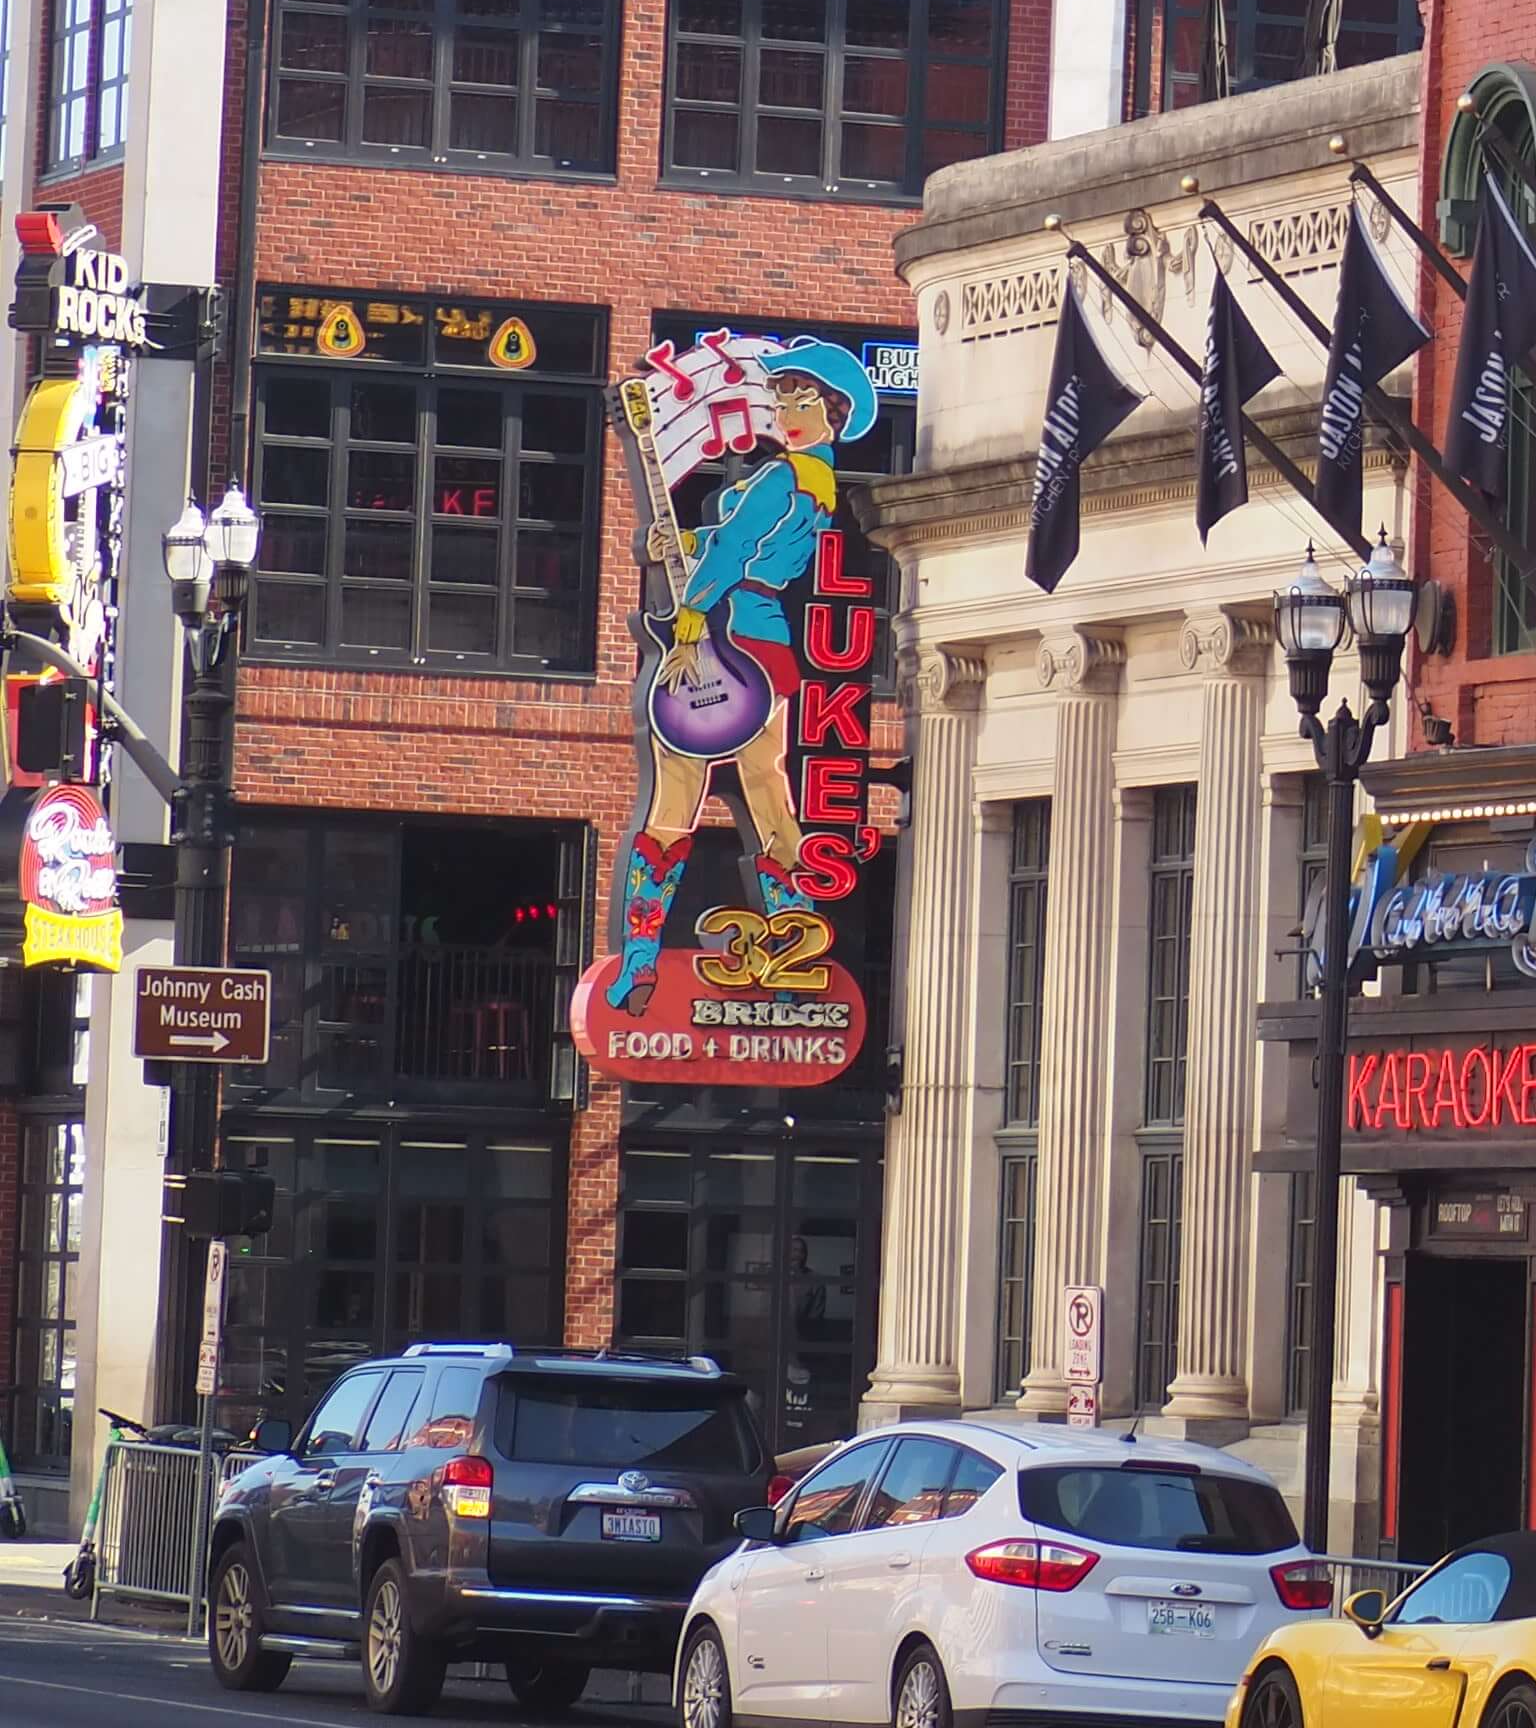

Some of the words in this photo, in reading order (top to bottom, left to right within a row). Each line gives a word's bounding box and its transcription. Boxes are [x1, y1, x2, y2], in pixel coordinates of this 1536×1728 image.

[75, 246, 129, 294] KID
[866, 366, 919, 389] LIGH
[692, 904, 837, 994] 32
[140, 975, 211, 1004] Johnny
[221, 978, 265, 1001] Cash
[160, 1005, 242, 1030] Museum
[691, 998, 851, 1030] BRIDGE
[607, 1030, 694, 1060] FOOD
[729, 1034, 847, 1065] DRINKS
